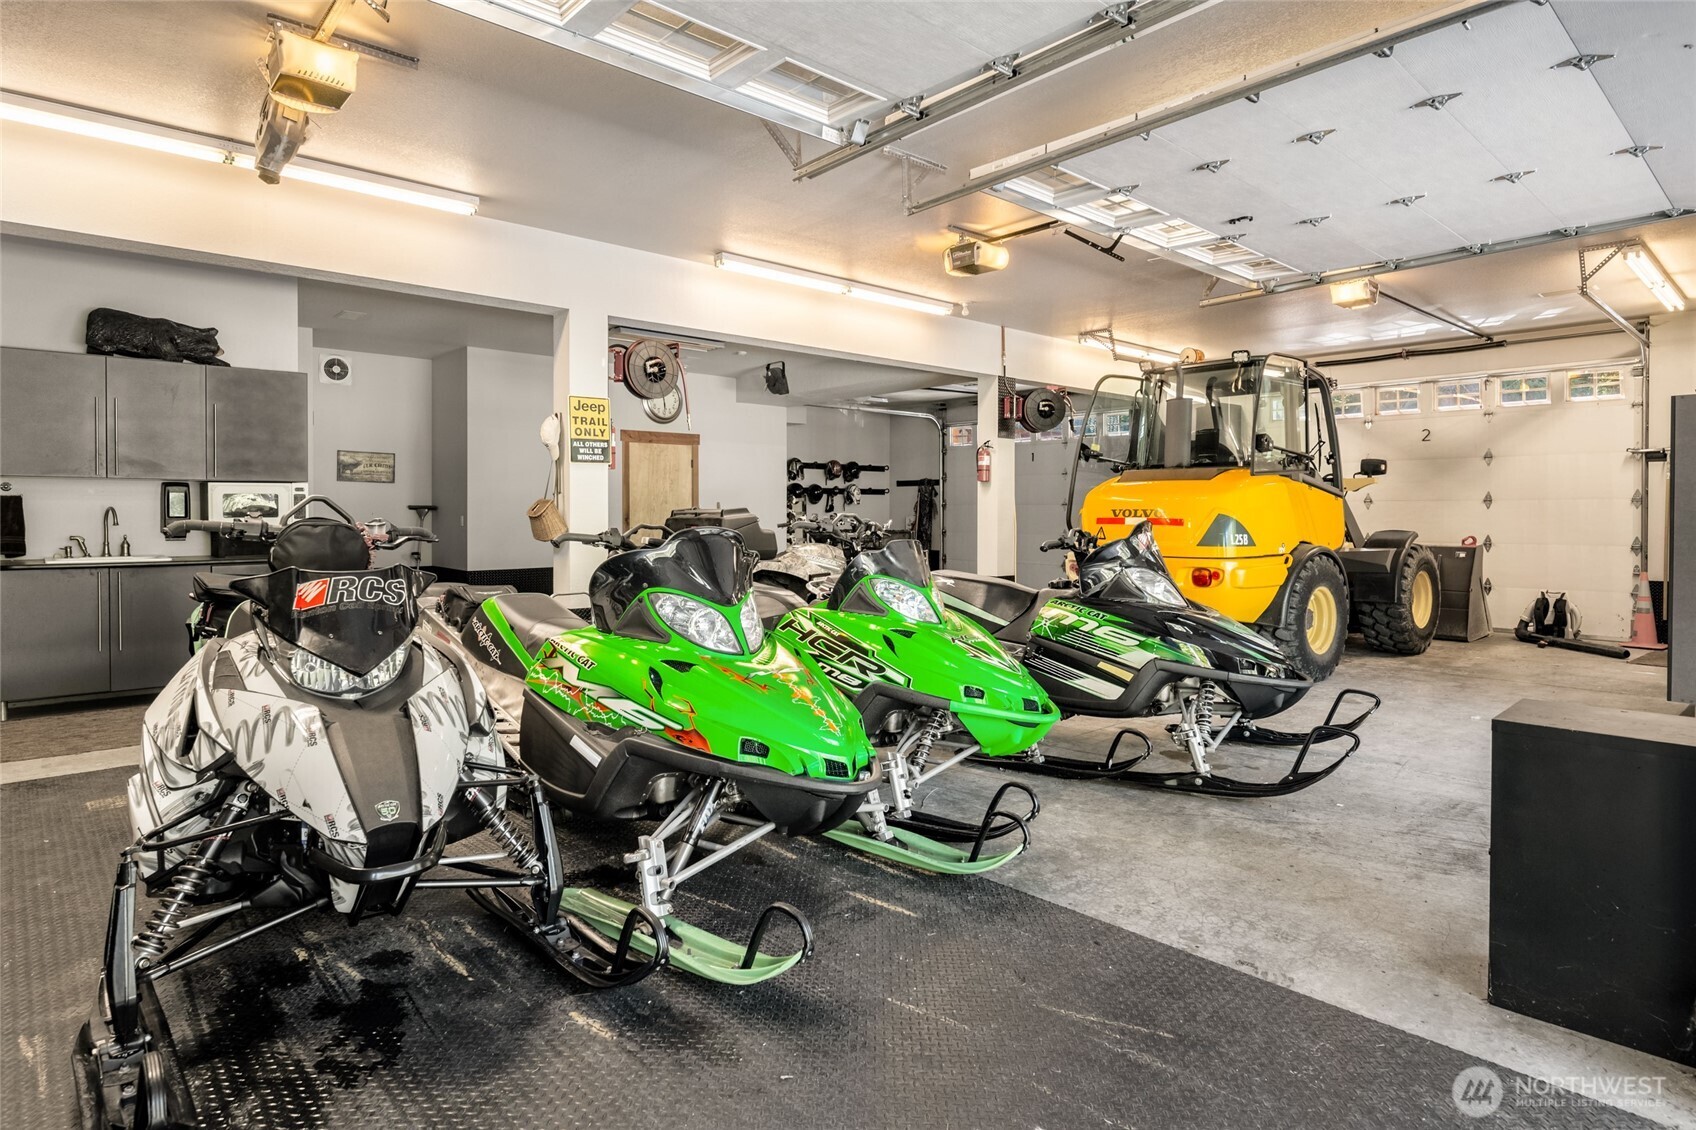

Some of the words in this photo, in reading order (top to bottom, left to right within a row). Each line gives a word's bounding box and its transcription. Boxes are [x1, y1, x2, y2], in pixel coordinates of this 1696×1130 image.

[573, 400, 606, 414] Jeep
[572, 416, 608, 426] TRAIL
[574, 427, 606, 437] ONLY
[1421, 428, 1431, 442] 2
[1111, 508, 1163, 518] VOLVO
[1230, 533, 1249, 545] L25B
[326, 575, 406, 606] RCS
[1050, 600, 1086, 614] ARCTIC
[1087, 610, 1109, 620] CAT
[472, 618, 491, 646] ARCTIC
[551, 639, 577, 659] ARCTIC
[577, 655, 596, 669] CAT
[778, 617, 887, 679] HCR
